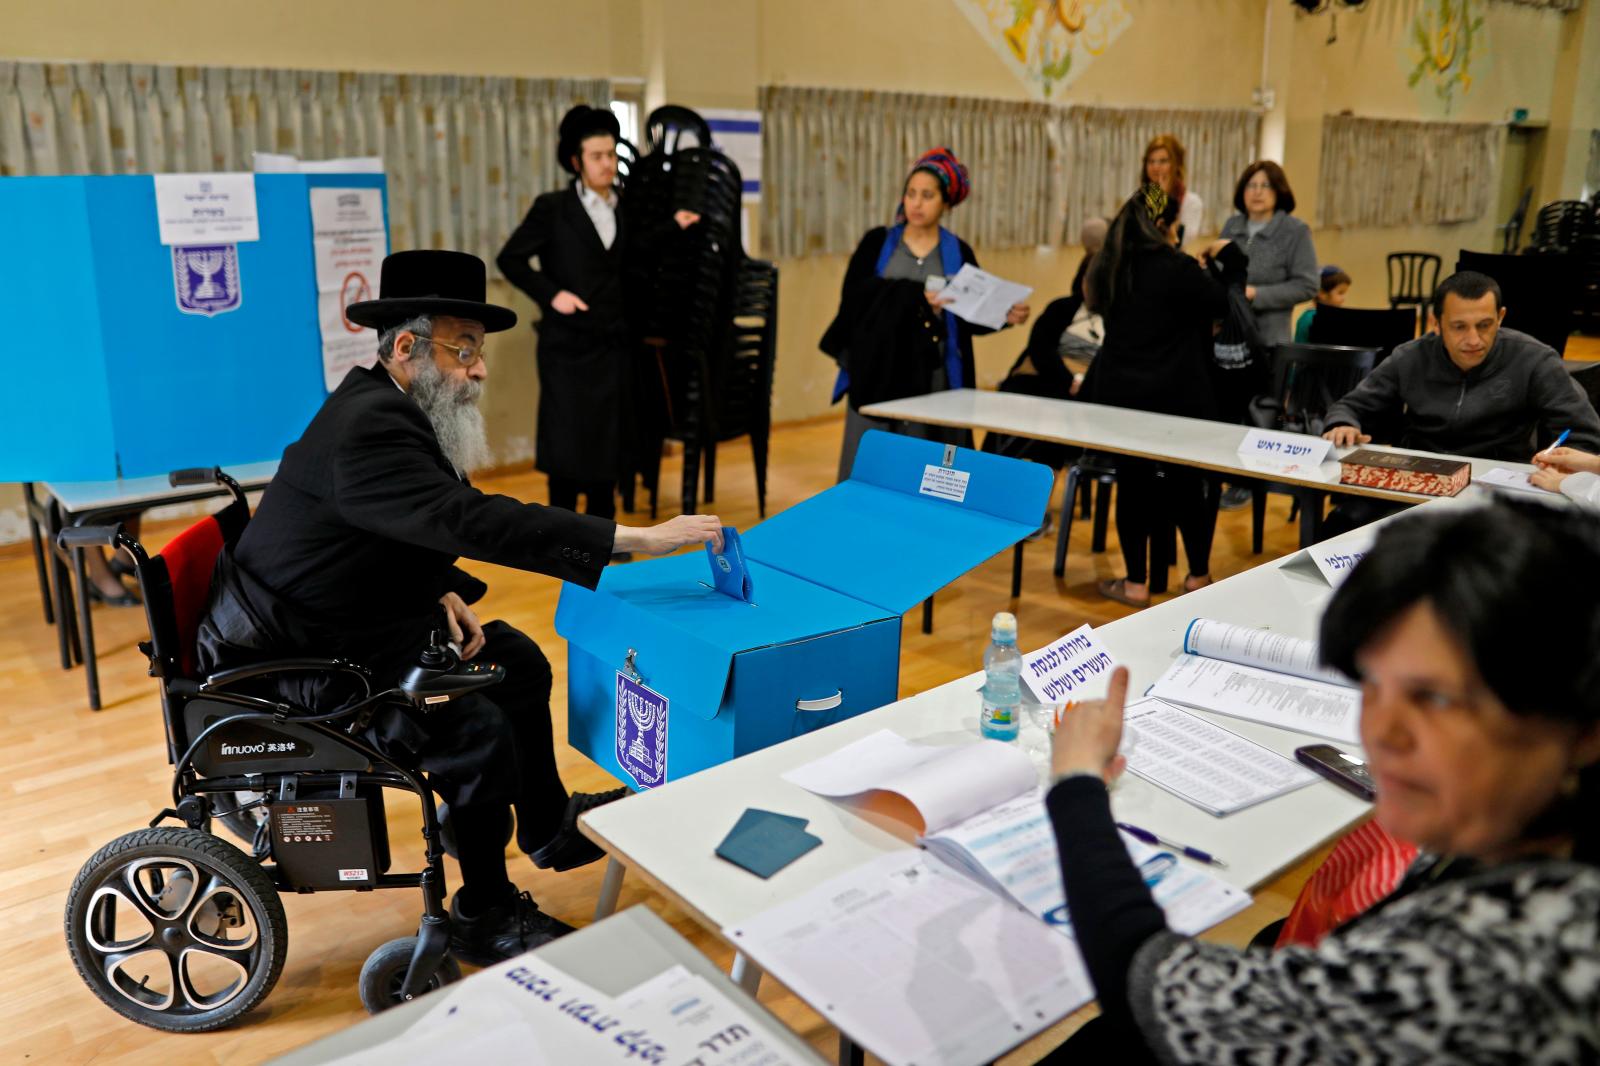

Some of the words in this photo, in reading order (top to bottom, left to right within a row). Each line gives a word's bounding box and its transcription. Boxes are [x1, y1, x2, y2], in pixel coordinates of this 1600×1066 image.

[1257, 440, 1282, 451] ראש
[1284, 444, 1312, 455] יושב
[1325, 553, 1353, 570] קלפי
[1058, 634, 1092, 661] בחירות
[1030, 649, 1062, 678] לכנסת
[1072, 652, 1113, 683] העשרים
[1042, 673, 1077, 701] ושלוש
[221, 742, 265, 755] innuovo
[613, 1029, 667, 1065] קלפי
